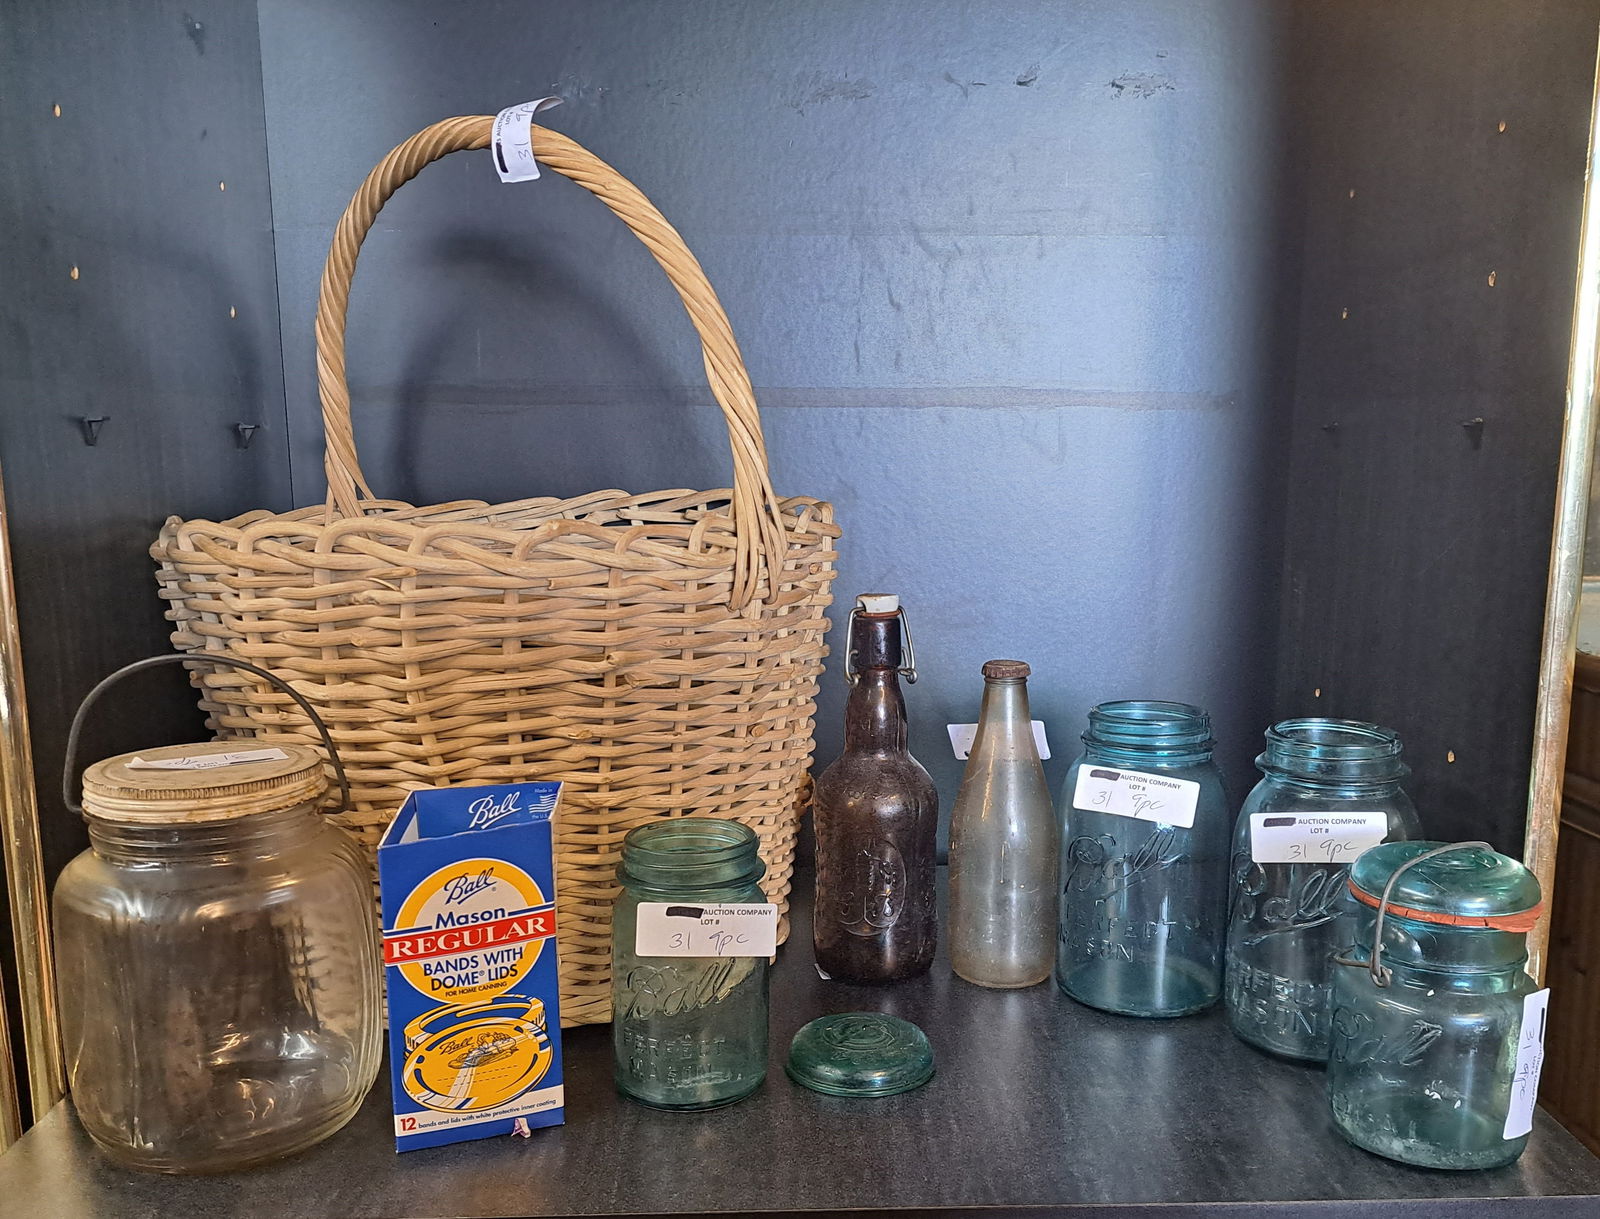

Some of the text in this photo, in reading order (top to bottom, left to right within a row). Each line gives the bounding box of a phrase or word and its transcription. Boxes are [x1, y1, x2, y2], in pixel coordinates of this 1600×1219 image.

[1119, 774, 1182, 791] AUCTION COMPANY
[1128, 783, 1141, 791] LOT
[1091, 791, 1113, 808] 31
[469, 791, 522, 829] Ball
[1287, 843, 1307, 861] 31
[1064, 826, 1191, 904] Ball
[444, 866, 498, 905] Ball
[435, 907, 507, 930] Mason
[702, 908, 773, 916] AUCTION COMPANY
[700, 918, 714, 926] LOT
[391, 916, 548, 959] REGULAR
[668, 931, 691, 950] 31
[423, 946, 524, 977] BANDS WITH
[488, 963, 518, 982] LIDS
[445, 980, 508, 998] FOR HOME CANNING
[623, 956, 737, 1021] Ball
[438, 1036, 475, 1056] Ball
[400, 1098, 557, 1132] 12 bands and lids with white protective inner coating
